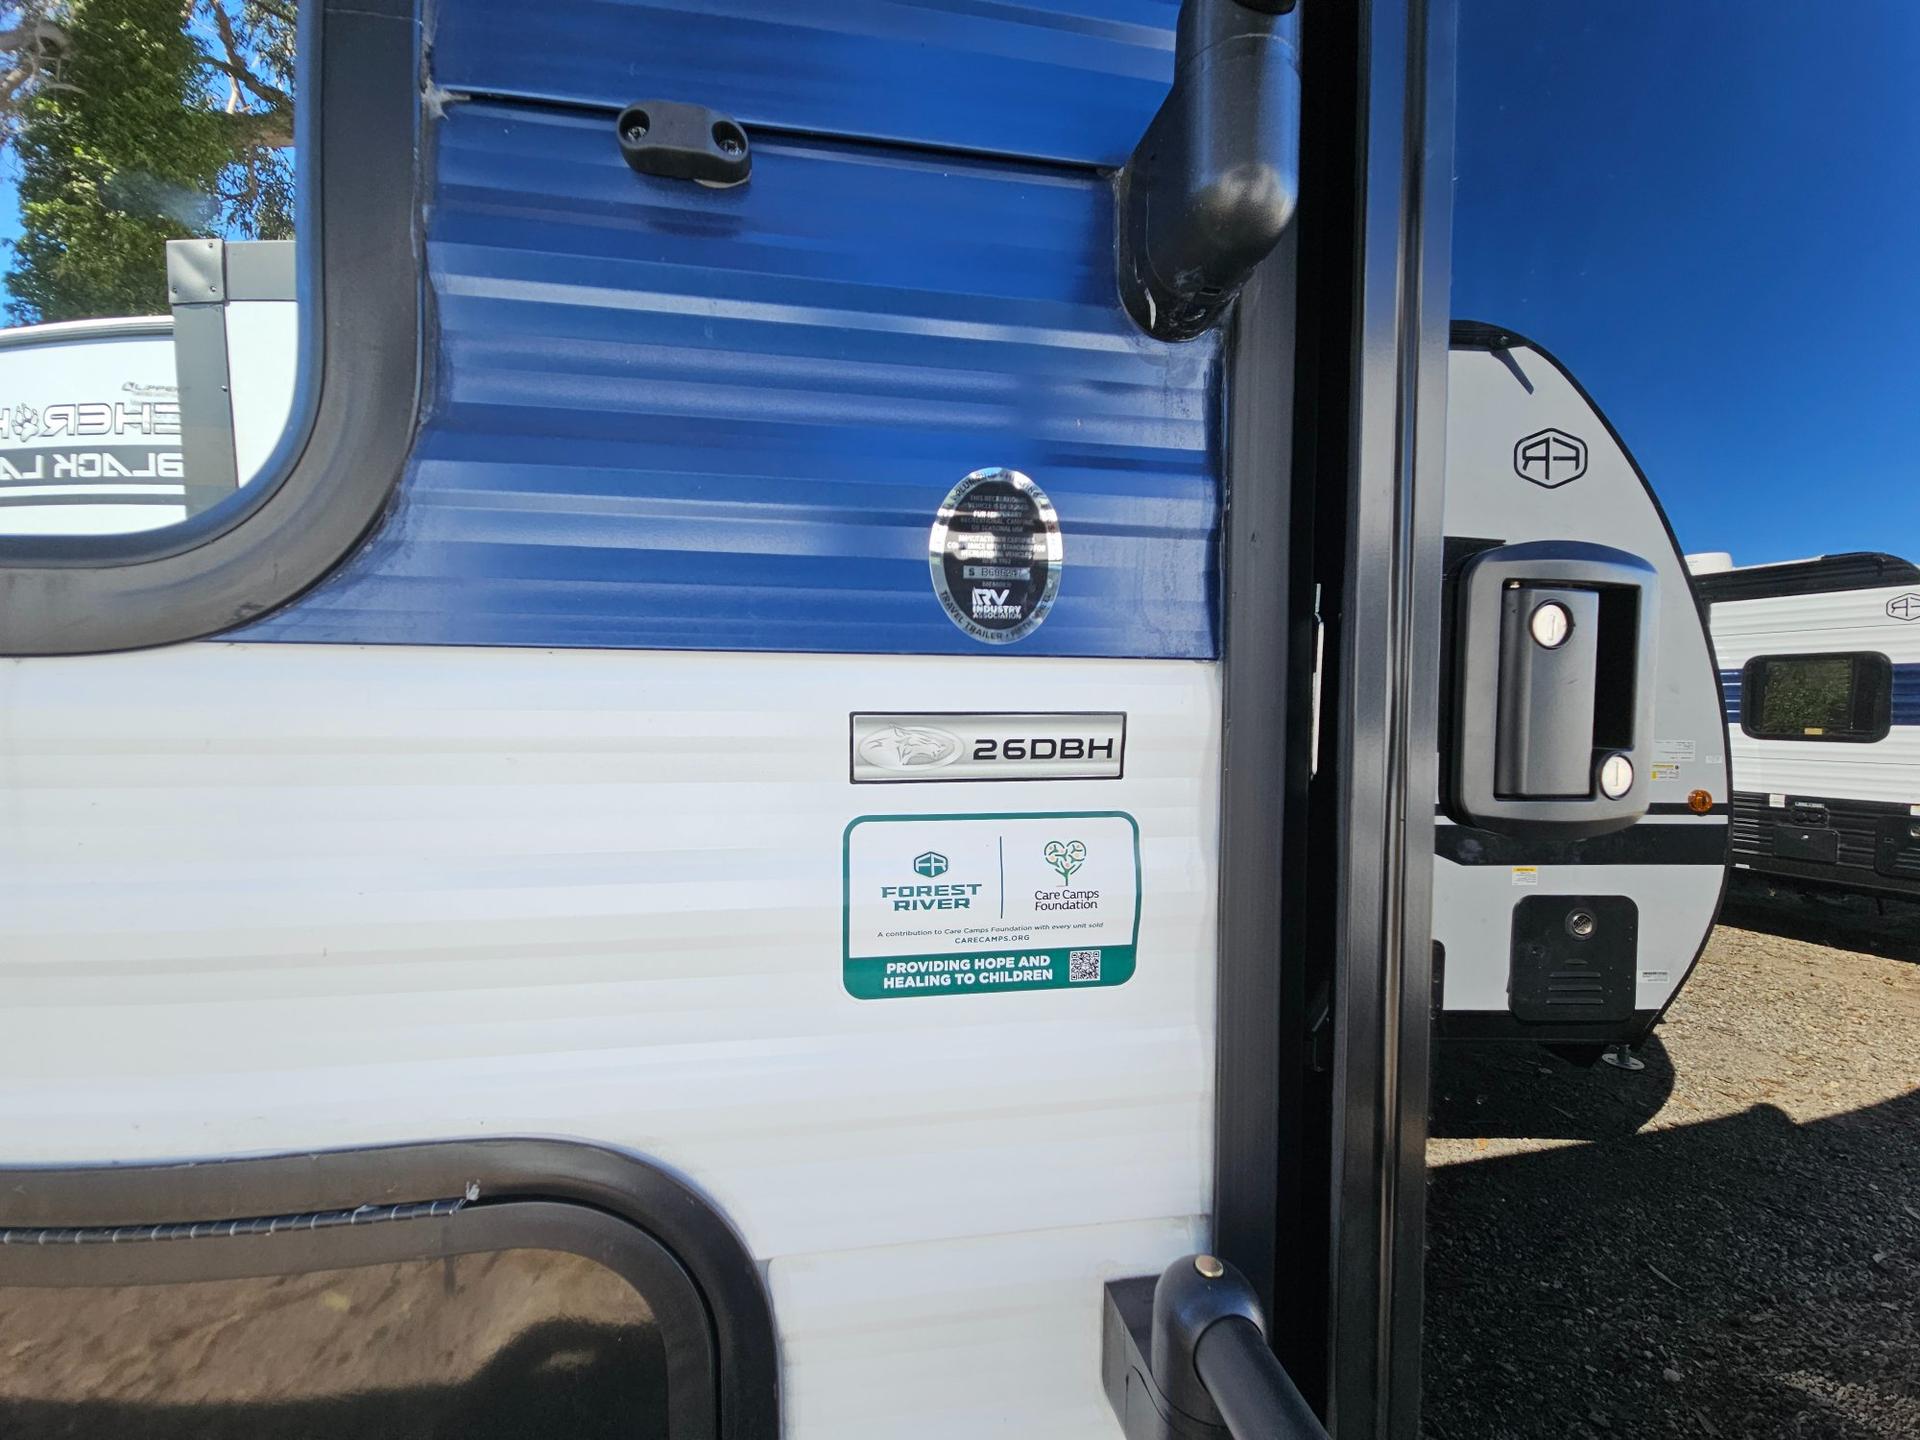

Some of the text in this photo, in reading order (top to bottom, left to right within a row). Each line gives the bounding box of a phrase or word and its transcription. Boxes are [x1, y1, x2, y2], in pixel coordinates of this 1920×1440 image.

[968, 568, 975, 577] S
[972, 586, 1010, 605] RV
[941, 590, 963, 624] TRAVEL
[965, 621, 1003, 639] TRAILER
[972, 605, 1022, 614] INDUSTRY
[973, 738, 1114, 760] 26DBH
[880, 883, 982, 898] FOREST
[1034, 889, 1099, 901] Care Camps
[893, 898, 970, 911] RIVER
[1035, 900, 1098, 911] Foundation
[885, 929, 932, 937] contribution
[963, 927, 989, 935] Camps
[991, 925, 1033, 933] Foundation
[954, 934, 1030, 944] CARECAMPS.ORG
[886, 955, 1051, 974] PROVIDING HOPE AND
[883, 968, 1053, 989] HEALING TO CHILDREN
